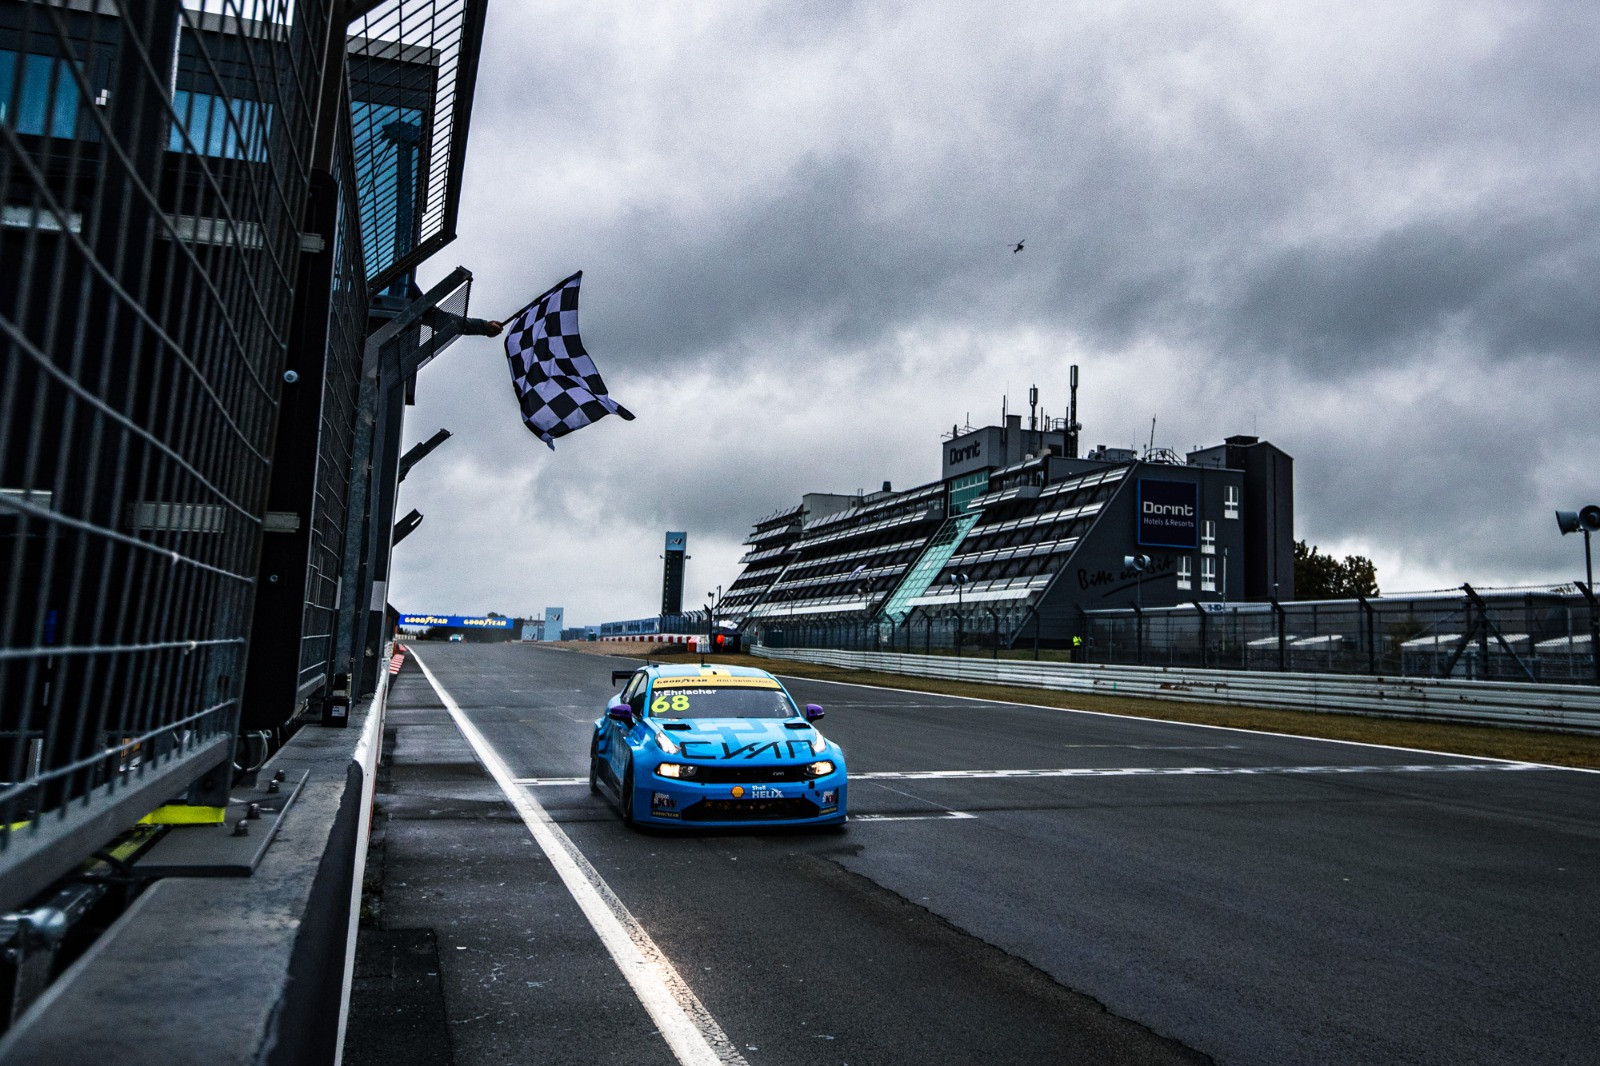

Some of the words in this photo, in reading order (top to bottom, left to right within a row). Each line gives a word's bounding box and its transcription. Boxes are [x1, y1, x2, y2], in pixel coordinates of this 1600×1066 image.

[949, 439, 981, 466] Dorint
[1142, 500, 1194, 517] Dorint
[1143, 517, 1164, 526] Hotels
[1164, 518, 1170, 527] &
[1170, 518, 1195, 528] Resorts
[404, 616, 448, 625] GOODYEAR
[463, 618, 507, 627] GOODYEAR
[650, 694, 691, 713] 68
[751, 788, 784, 799] HELIX
